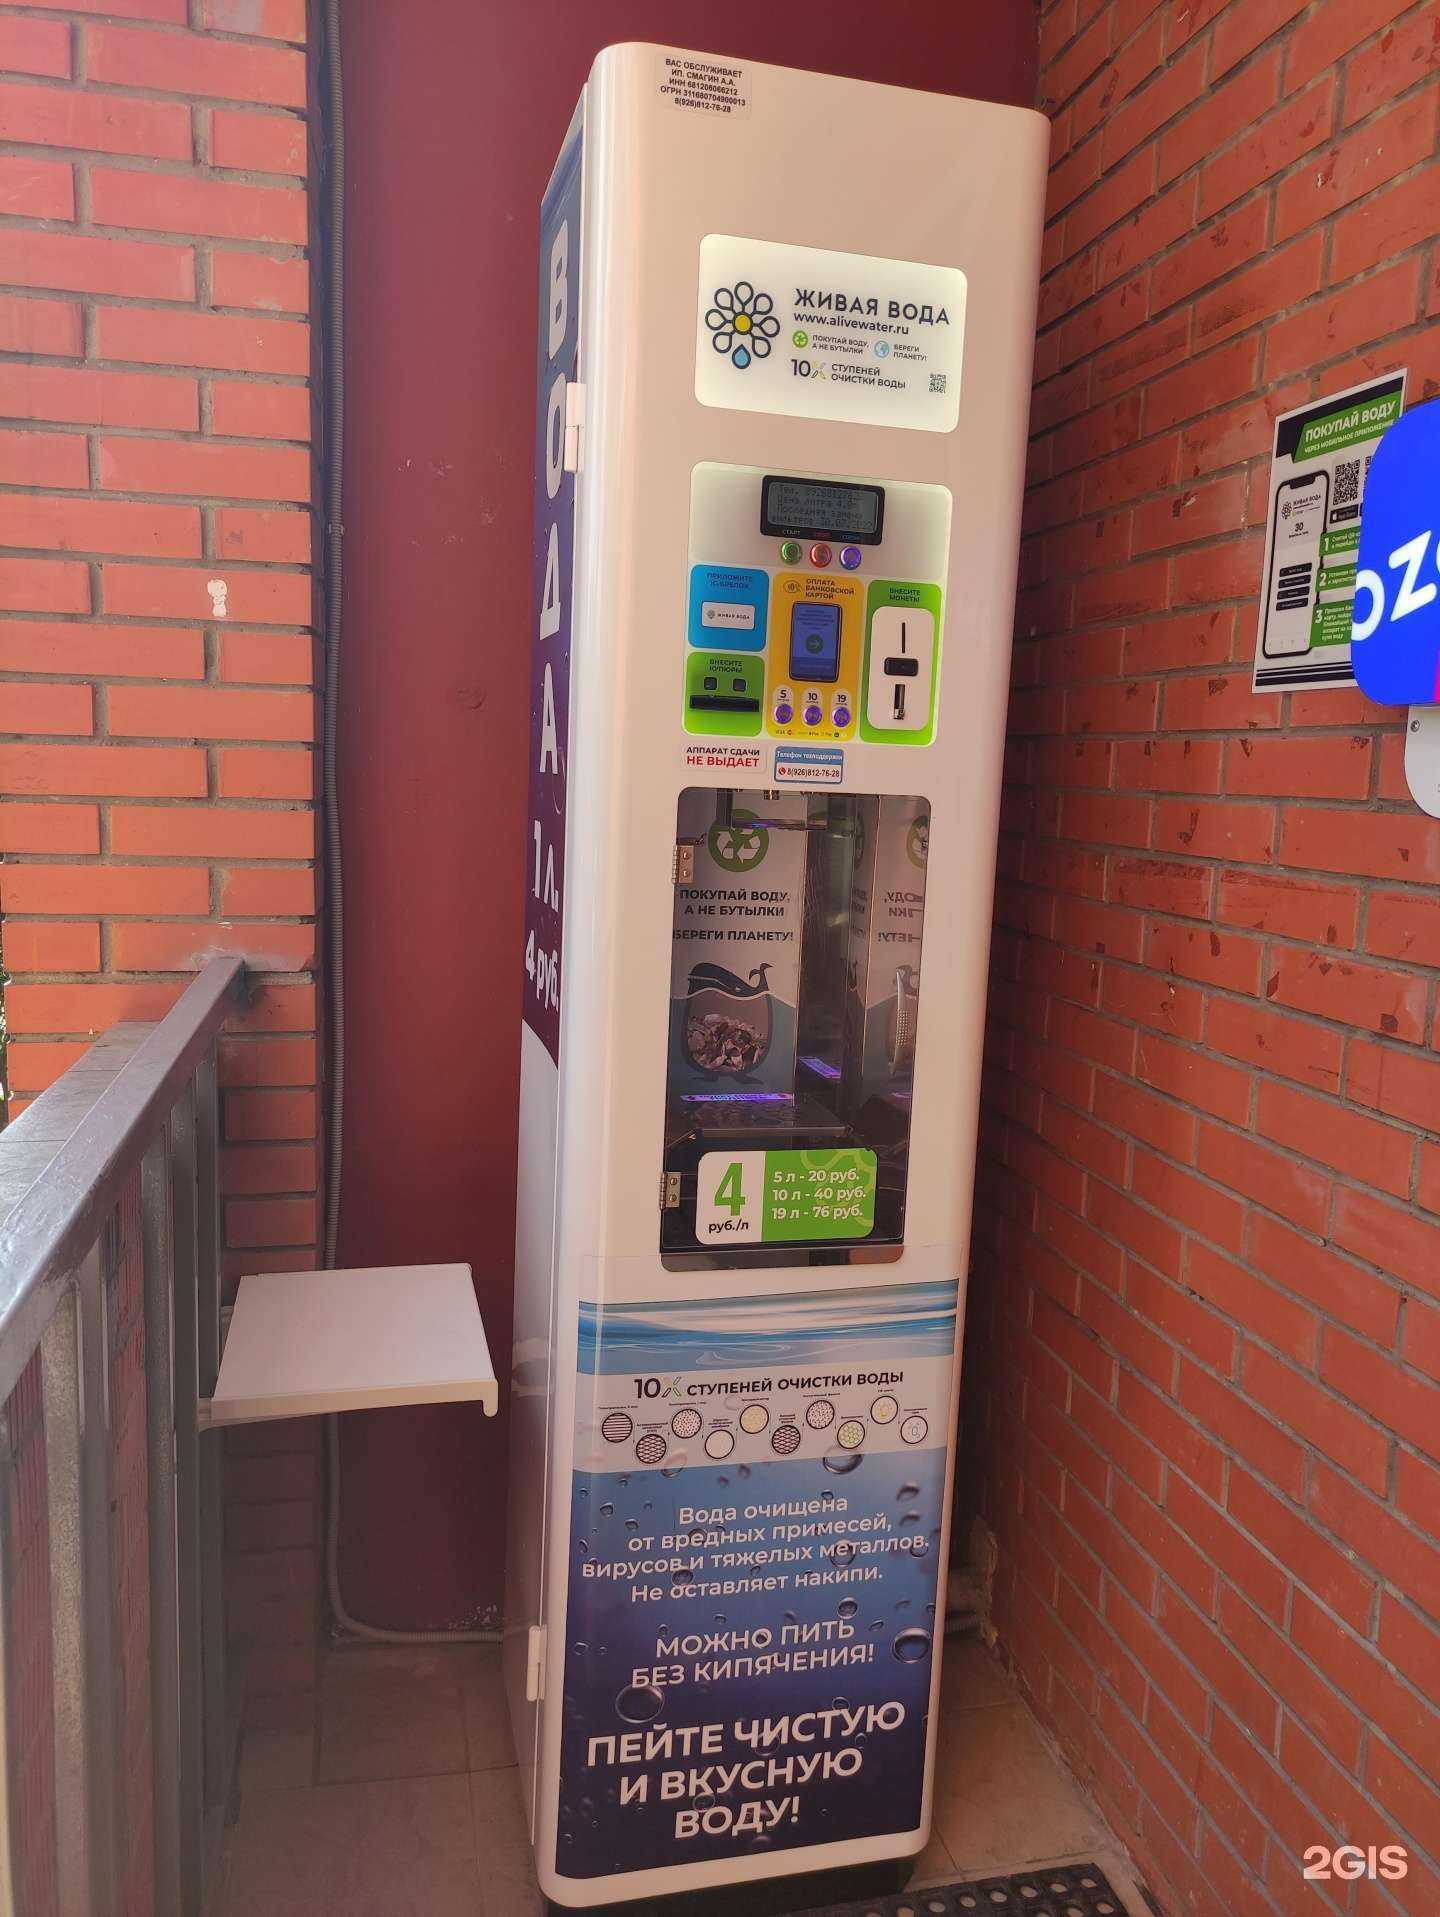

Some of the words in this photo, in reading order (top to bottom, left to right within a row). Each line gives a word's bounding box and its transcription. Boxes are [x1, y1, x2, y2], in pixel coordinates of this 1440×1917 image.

[666, 58, 682, 68] ВАС
[684, 62, 742, 78] ОБСЛУЖИВАЕТ
[669, 78, 686, 86] ИНН
[672, 69, 684, 78] ИП.
[686, 72, 719, 82] СМАГИН
[721, 78, 736, 86] А.А.
[660, 86, 682, 95] ОГРН
[794, 288, 878, 316] ЖИВАЯ
[888, 299, 950, 326] ВОДА
[793, 311, 909, 335] www.alivewater.ru
[812, 334, 846, 345] ПОКУПАЙ
[848, 339, 869, 348] ВОДУ,
[894, 344, 920, 352] БЕРЕГИ
[830, 345, 863, 354] БУТЫЛКИ
[894, 352, 927, 361] ПЛАНЕТУ!
[831, 363, 880, 376] СТУПЕНЕЙ
[831, 374, 875, 386] ОЧИСТКИ
[878, 378, 906, 389] ВОДЫ
[1305, 411, 1360, 442] ПОКУПАЙ
[1362, 400, 1396, 424] ВОДУ
[1304, 443, 1320, 453] ЧЕРЕЗ
[1320, 432, 1354, 448] МОБИЛЬНОЕ
[1294, 522, 1304, 532] 30
[1324, 537, 1329, 552] 1
[706, 572, 752, 582] ПРИЛОЖИТЕ
[806, 578, 835, 586] ОПЛАТА
[1319, 572, 1326, 586] 2
[806, 585, 854, 595] БАНКОВСКОЙ
[806, 592, 834, 600] КАРТОЙ
[889, 588, 920, 596] ВНЕСИТЕ
[889, 594, 920, 602] МОНЕТЫ
[1314, 610, 1322, 624] 3
[710, 658, 742, 667] ВНЕСИТЕ
[780, 690, 786, 698] 5
[808, 692, 818, 700] 10
[837, 694, 846, 702] 19
[686, 746, 729, 756] АППАРАТ
[730, 747, 760, 757] СДАЧИ
[686, 756, 704, 766] НЕ
[706, 756, 760, 768] ВЫДАЕТ
[787, 768, 840, 778] 8(926)812-76-28
[679, 888, 747, 901] ПОКУПАЙ
[684, 905, 694, 915] А
[698, 906, 714, 916] НЕ
[720, 906, 784, 917] БУТЫЛКИ
[673, 929, 724, 940] БЕРЕГИ
[728, 930, 793, 942] ПЛАНЕТУ!
[773, 1172, 783, 1183] 5
[786, 1174, 796, 1182] л
[808, 1170, 826, 1182] 20
[830, 1168, 860, 1184] руб.
[714, 1162, 746, 1216] 4
[772, 1189, 788, 1201] 10
[791, 1191, 800, 1200] л
[814, 1188, 832, 1200] 40
[836, 1186, 866, 1202] руб.
[772, 1207, 786, 1220] 19
[790, 1210, 800, 1219] л
[812, 1206, 830, 1218] 76
[833, 1204, 862, 1221] руб.
[708, 1218, 749, 1234] руб./л
[687, 1378, 772, 1396] СТУПЕНЕЙ
[778, 1374, 852, 1390] ОЧИСТКИ
[857, 1372, 904, 1386] ВОДЫ
[679, 1506, 737, 1526] Вода
[744, 1498, 848, 1519] очищена
[628, 1535, 654, 1552] от
[661, 1526, 765, 1552] вредных
[772, 1514, 892, 1542] примесей,
[582, 1557, 685, 1580] вирусов
[690, 1556, 704, 1570] и
[710, 1546, 812, 1570] тяжелых
[819, 1533, 930, 1558] металлов.
[631, 1584, 663, 1602] Не
[670, 1575, 788, 1599] оставляет
[794, 1566, 883, 1589] накипи.
[656, 1628, 772, 1658] МОЖНО
[781, 1618, 855, 1645] ПИТЬ
[632, 1665, 685, 1689] БЕЗ
[694, 1644, 874, 1682] КИПЯЧЕНИЯ!
[587, 1723, 724, 1767] ПЕЙТЕ
[734, 1701, 906, 1748] ЧИСТУЮ
[620, 1775, 648, 1805] И
[660, 1748, 863, 1800] ВКУСНУЮ
[674, 1796, 800, 1839] ВОДУ!
